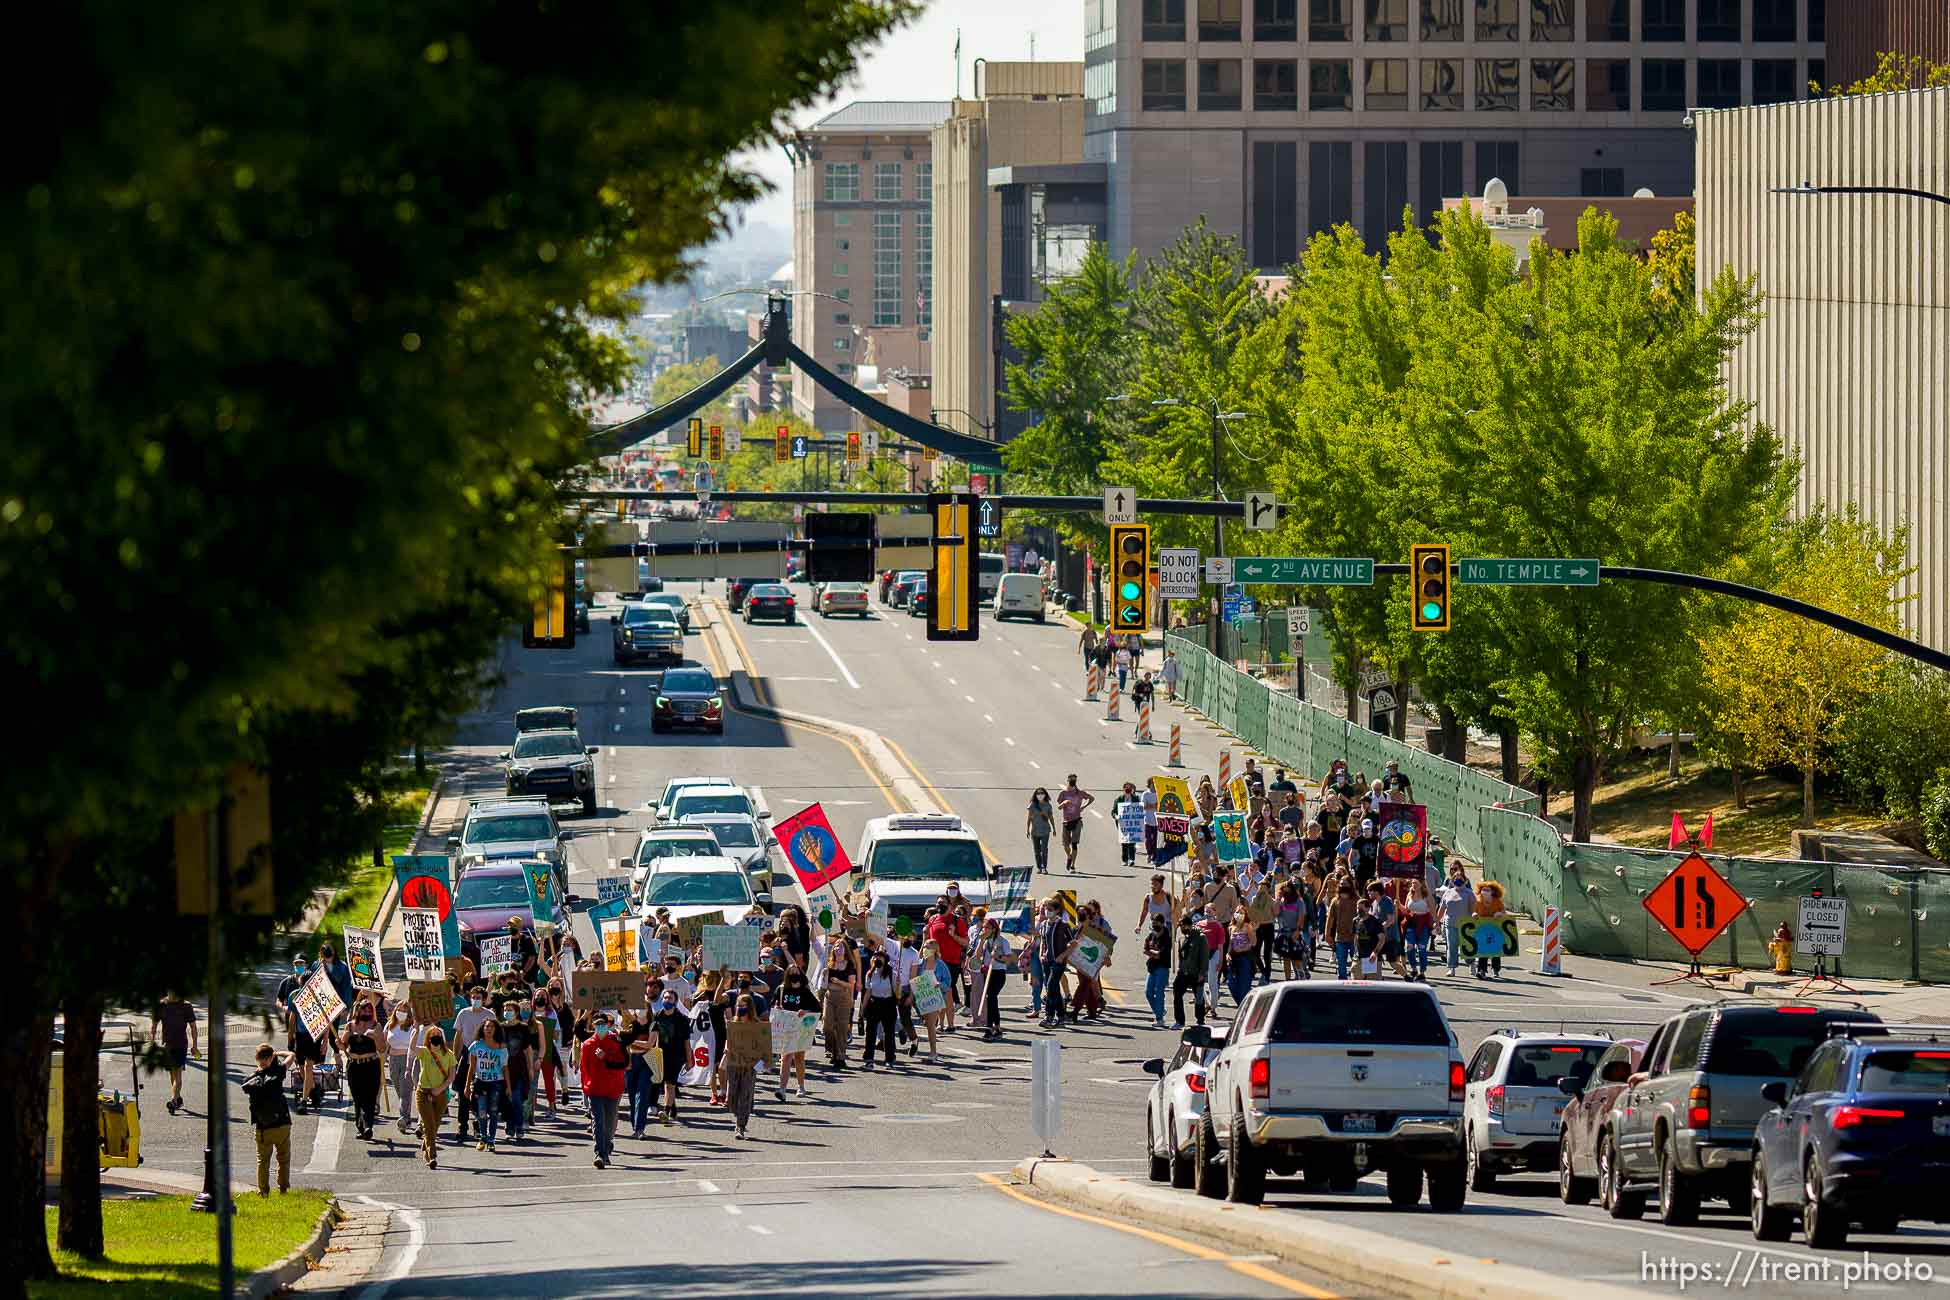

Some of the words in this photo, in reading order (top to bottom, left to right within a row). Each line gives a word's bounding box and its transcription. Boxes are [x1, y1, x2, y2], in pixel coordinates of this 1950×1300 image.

[1109, 514, 1130, 522] ONLY
[978, 526, 998, 535] NLY
[1161, 555, 1175, 567] DO
[1178, 555, 1197, 567] NOT
[1161, 571, 1197, 583] BLOCK
[1300, 563, 1366, 579] AVENUE
[1497, 564, 1563, 579] TEMPLE
[1161, 585, 1197, 594] INTERSECTION
[1290, 621, 1309, 632] 30
[1366, 673, 1386, 685] EAST
[1375, 695, 1391, 705] 186
[1157, 817, 1190, 834] DIVEST
[1164, 834, 1184, 843] FROM
[1802, 899, 1844, 910] SIDEWALK
[402, 912, 436, 928] PROTECT
[1806, 911, 1839, 922] CLOSED
[348, 935, 374, 948] DEFEND
[404, 930, 439, 945] CLIMATE
[1798, 931, 1814, 942] USE
[1816, 933, 1842, 944] OTHER
[406, 944, 440, 957] WATER
[1810, 944, 1829, 953] SIDE
[407, 957, 441, 972] HEALTH
[355, 977, 383, 990] FUTURE
[479, 1061, 496, 1070] OUR
